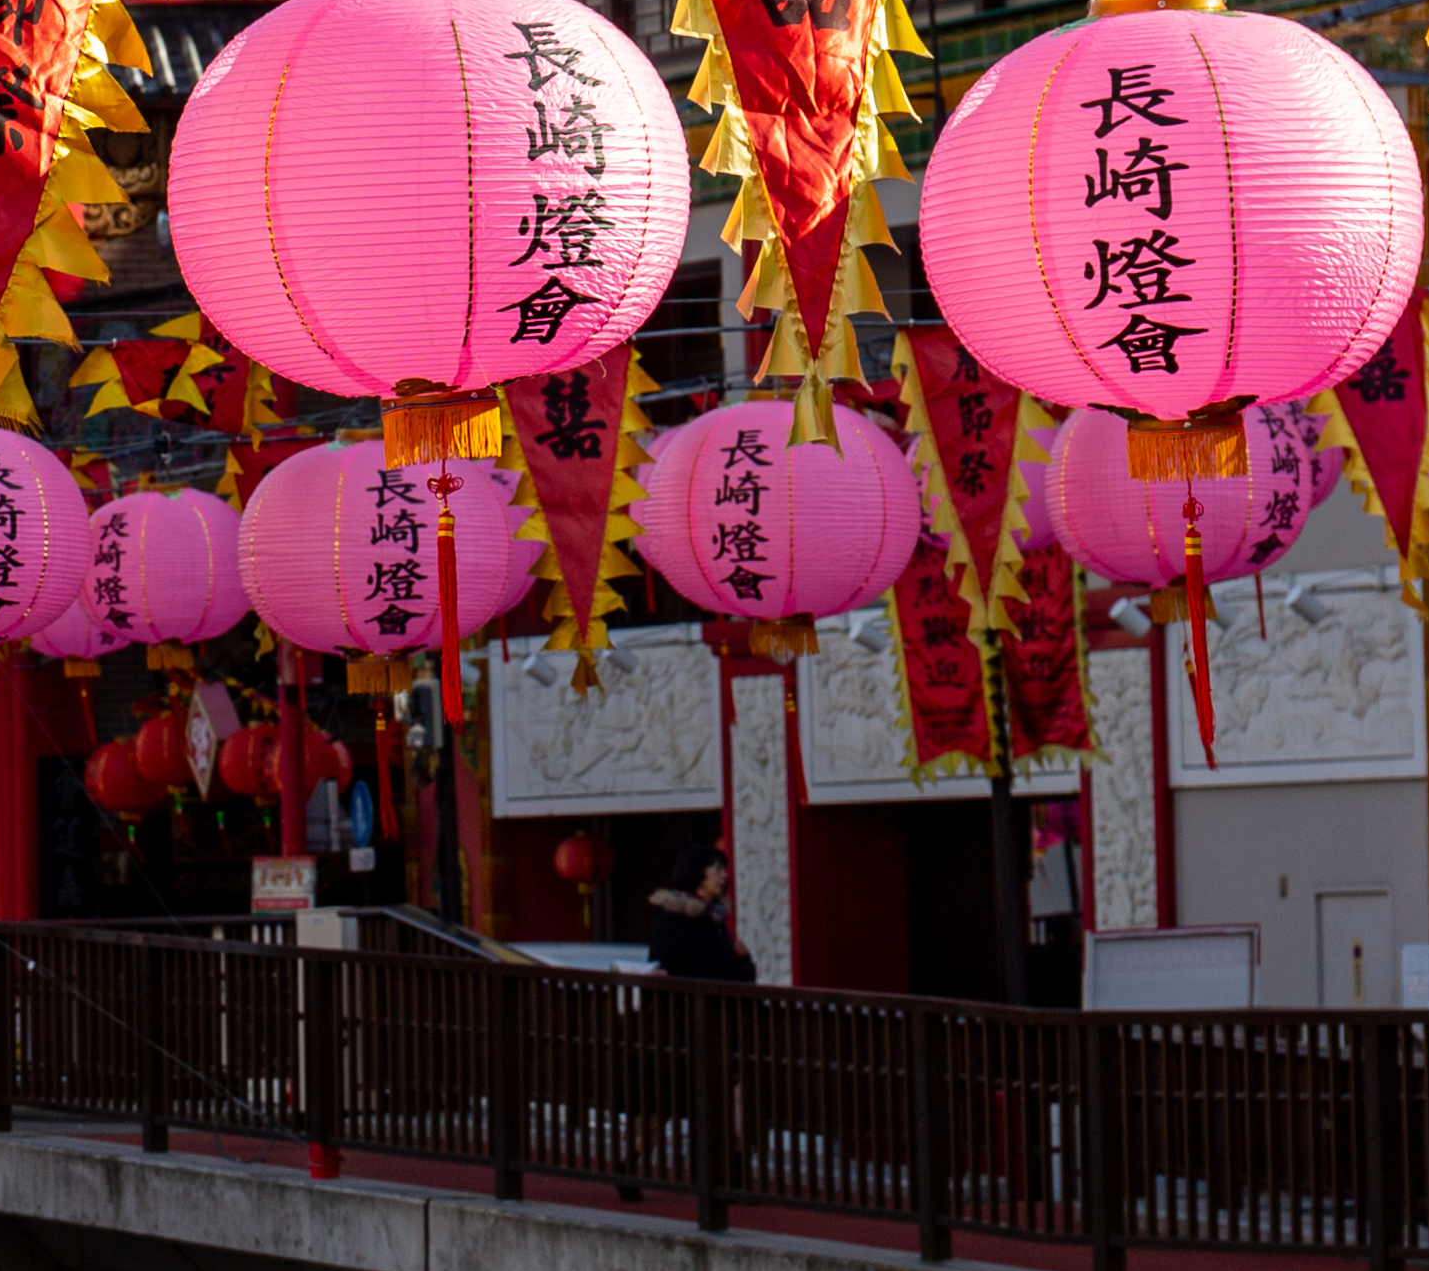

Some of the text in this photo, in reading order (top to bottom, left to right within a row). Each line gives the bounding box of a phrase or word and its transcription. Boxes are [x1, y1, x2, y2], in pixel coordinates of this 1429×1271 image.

[497, 21, 616, 345] 長崎燈會
[1081, 63, 1209, 375] 長崎燈會
[93, 512, 135, 630] 長崎燈會
[364, 469, 428, 636] 長崎燈會
[712, 430, 776, 602] 長崎燈會
